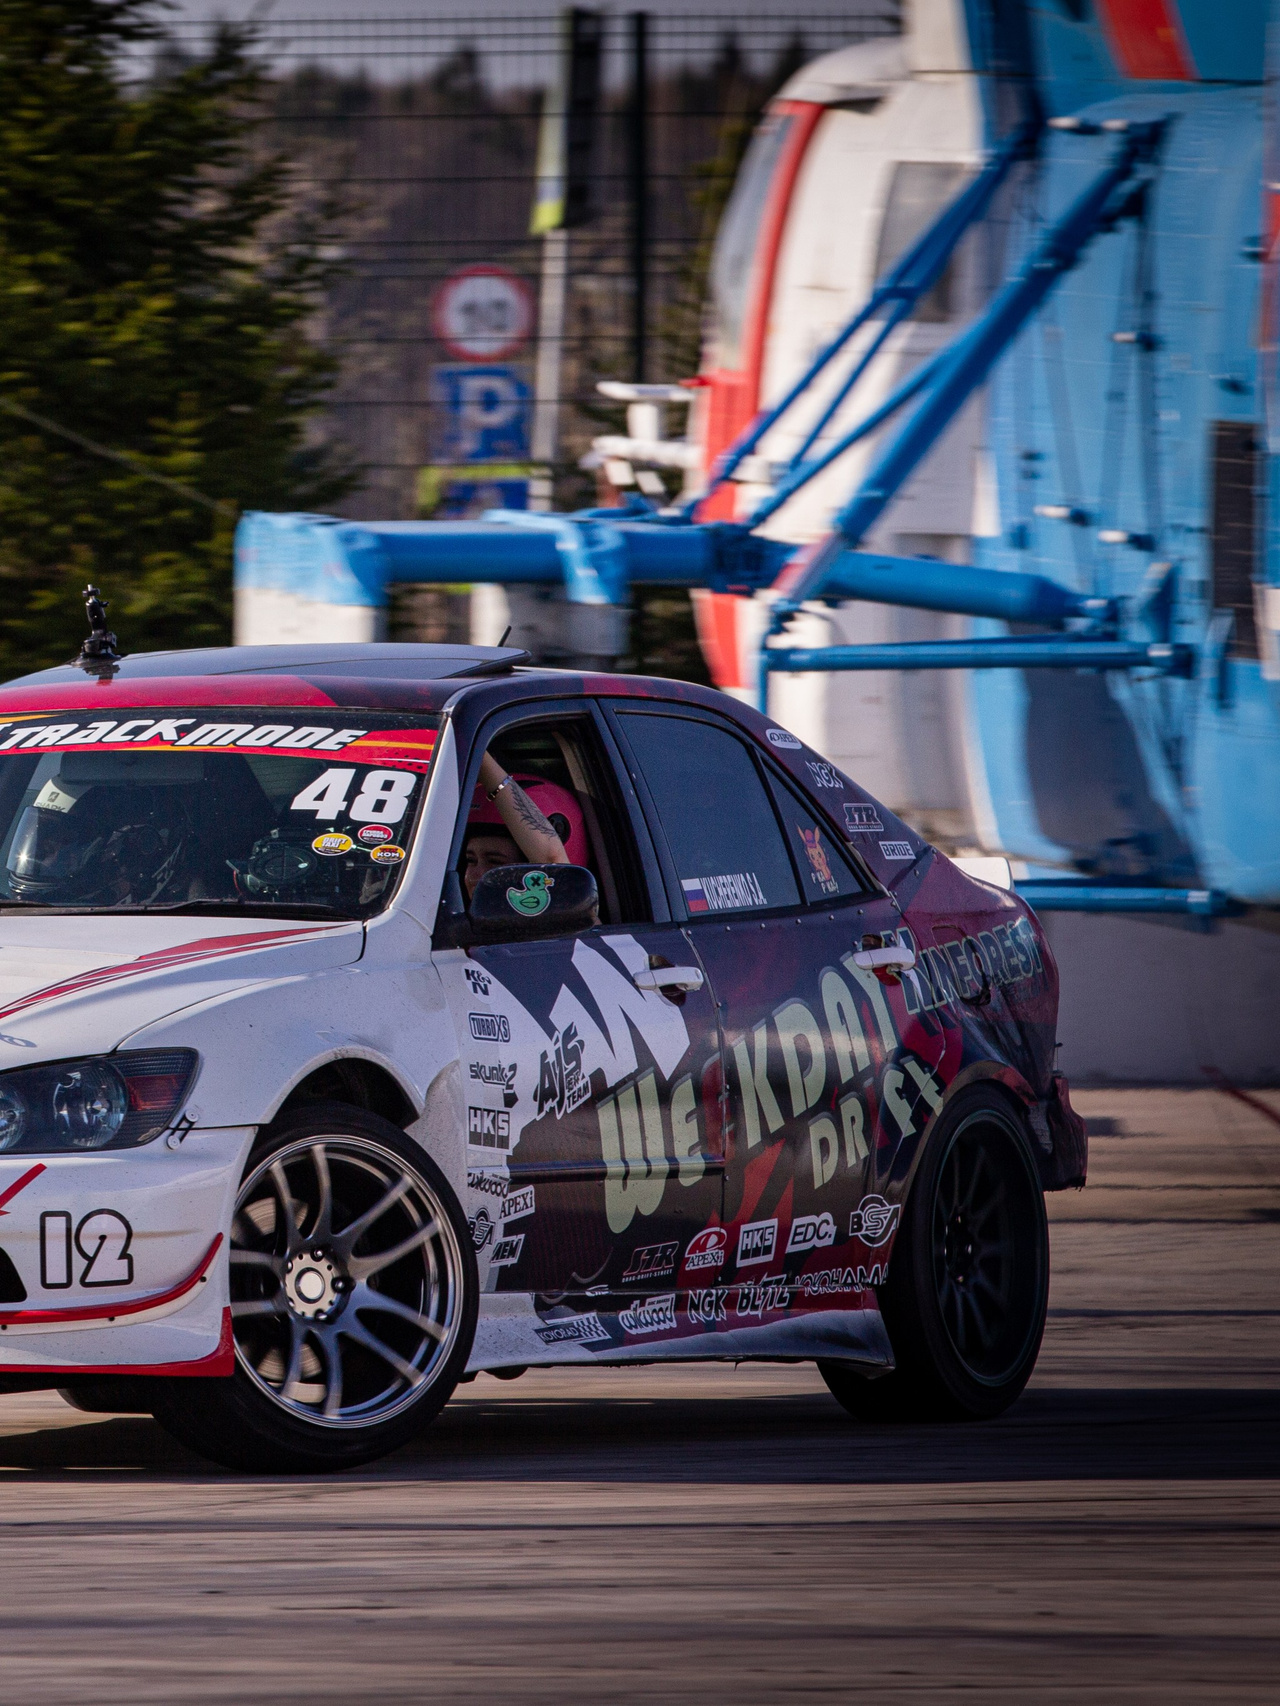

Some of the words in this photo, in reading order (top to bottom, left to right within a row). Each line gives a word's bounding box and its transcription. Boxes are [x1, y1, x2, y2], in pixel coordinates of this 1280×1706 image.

[805, 760, 844, 789] NGK
[290, 769, 417, 824] 48
[881, 843, 914, 857] BRIDE
[567, 1080, 591, 1109] TEAM
[468, 1108, 510, 1138] HKS
[40, 1208, 134, 1290] 12
[741, 1227, 775, 1251] HKS
[687, 1288, 728, 1323] NGK
[538, 1325, 580, 1342] KOYORAD
